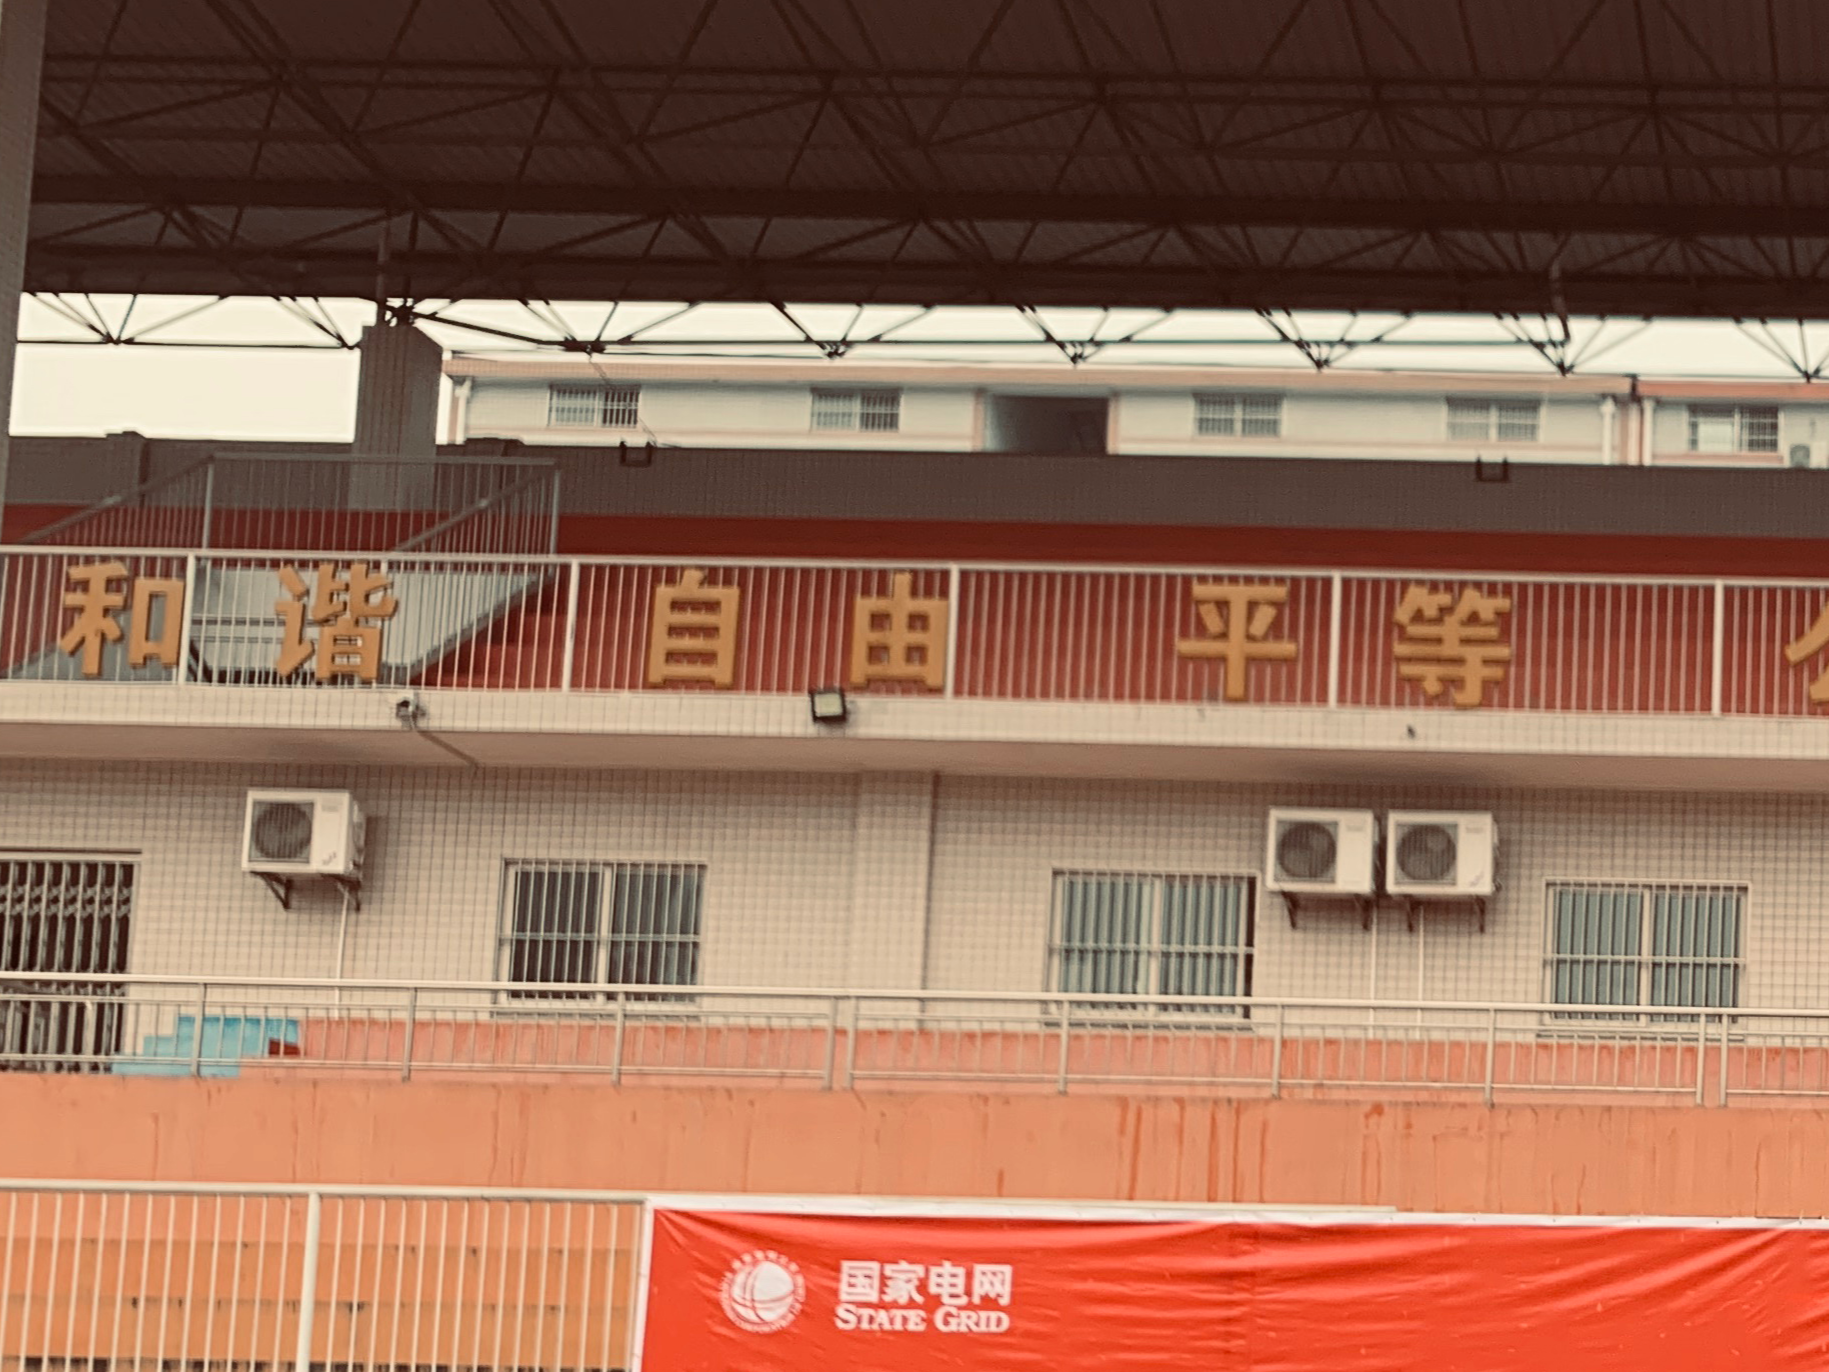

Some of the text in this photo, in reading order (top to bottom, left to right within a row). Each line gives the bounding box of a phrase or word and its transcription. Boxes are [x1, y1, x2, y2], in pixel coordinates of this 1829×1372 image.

[59, 560, 398, 682] 和谐
[648, 569, 949, 690] 自由
[1176, 582, 1513, 708] 平等
[839, 1259, 1013, 1307] 国家电网
[835, 1303, 1010, 1333] STATE GRID
